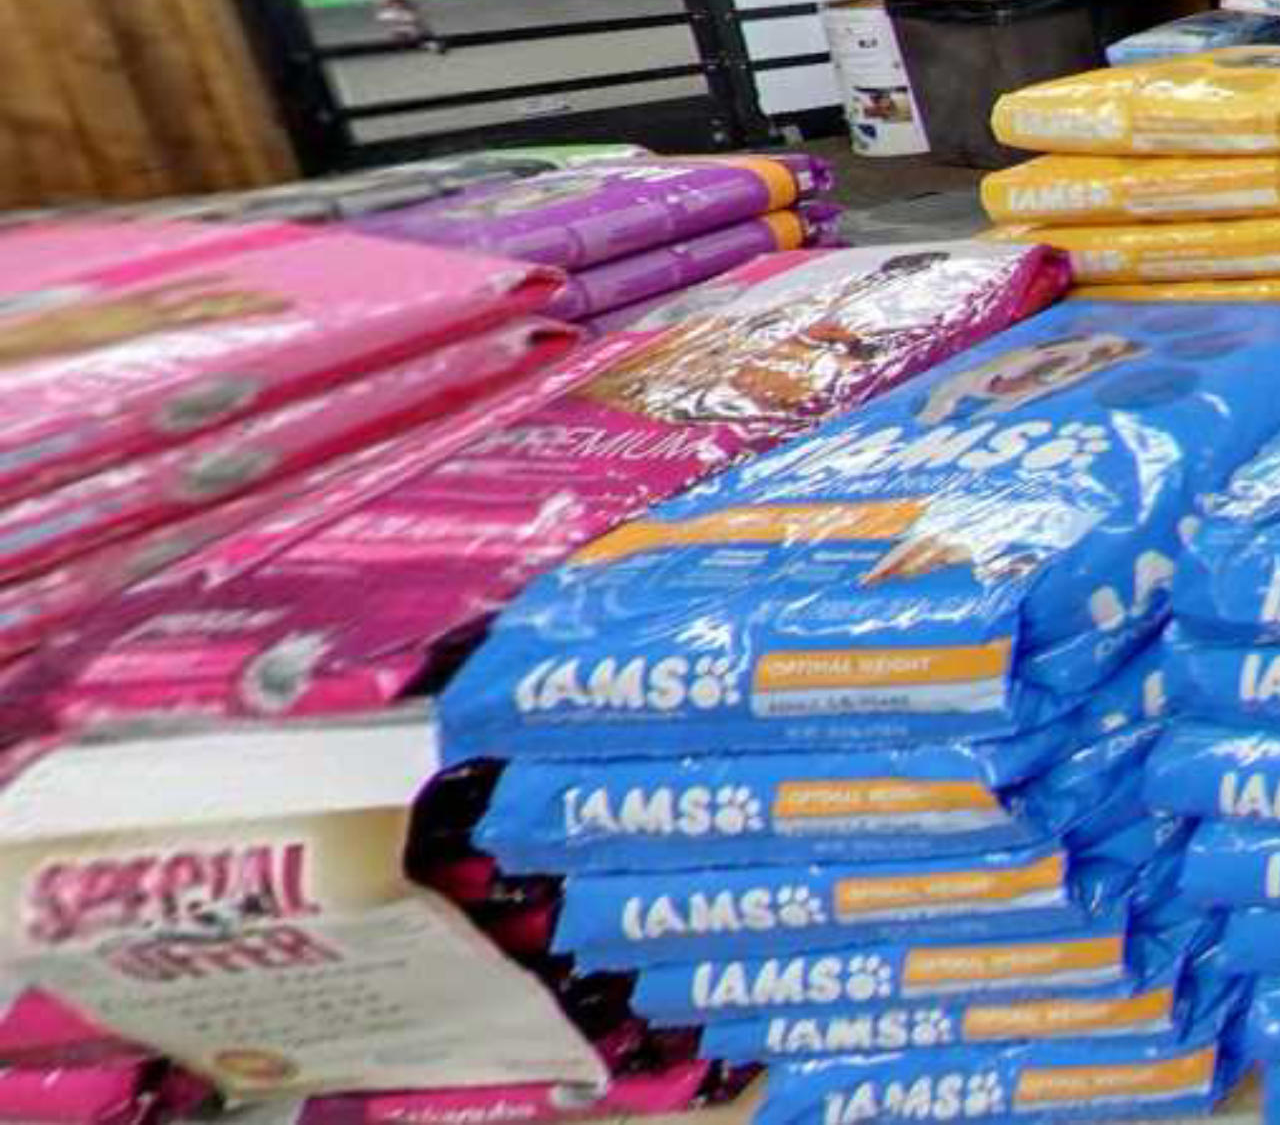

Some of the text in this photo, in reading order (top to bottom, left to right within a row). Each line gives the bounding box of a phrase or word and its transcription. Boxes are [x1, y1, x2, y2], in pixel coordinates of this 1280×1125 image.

[513, 655, 690, 713] IAMS
[564, 787, 710, 835] IAMS
[623, 889, 770, 939] IAMS
[692, 958, 843, 1008] IAMS
[766, 1012, 911, 1050] IAMS
[823, 1075, 982, 1125] IAMS
